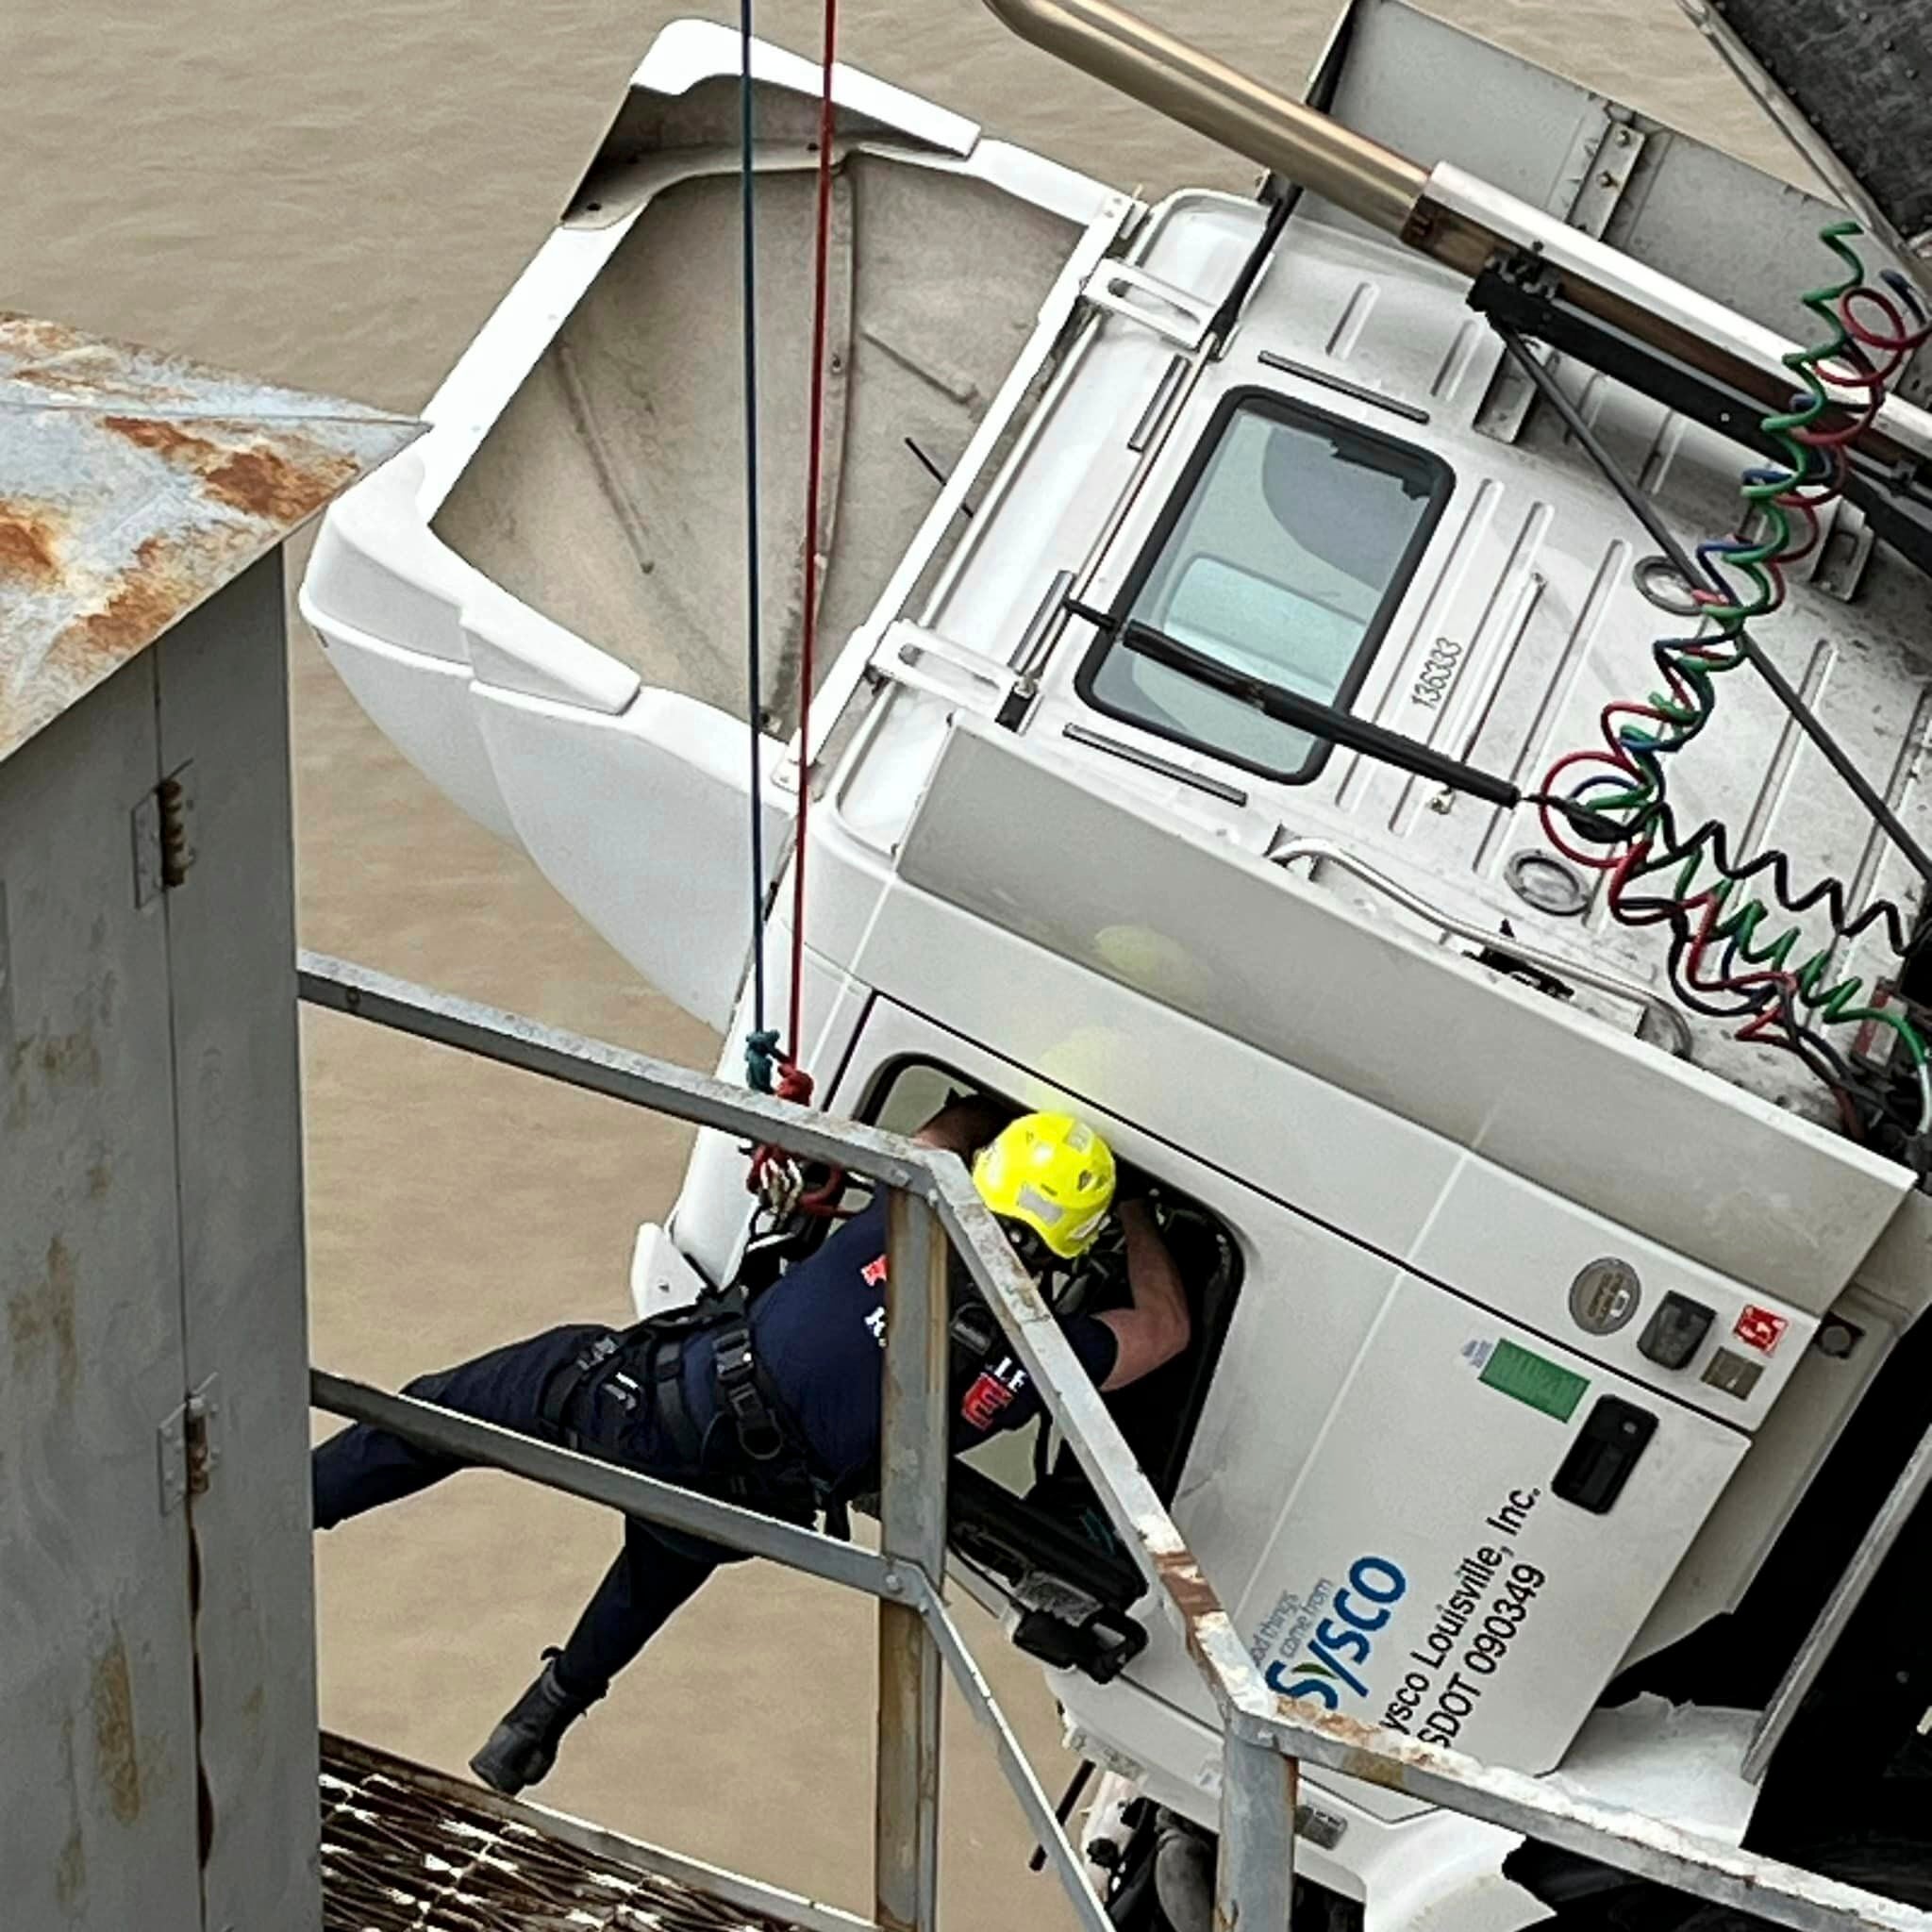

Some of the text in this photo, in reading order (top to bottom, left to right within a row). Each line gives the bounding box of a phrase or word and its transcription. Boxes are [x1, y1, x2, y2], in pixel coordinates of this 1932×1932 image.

[1411, 637, 1462, 709] 136333
[1279, 1578, 1334, 1658] come from
[1379, 1672, 1430, 1735] ysco
[1410, 1545, 1515, 1670] Louisville,
[1486, 1488, 1541, 1537] Inc.
[1417, 1563, 1547, 1748] SDOT 090349
